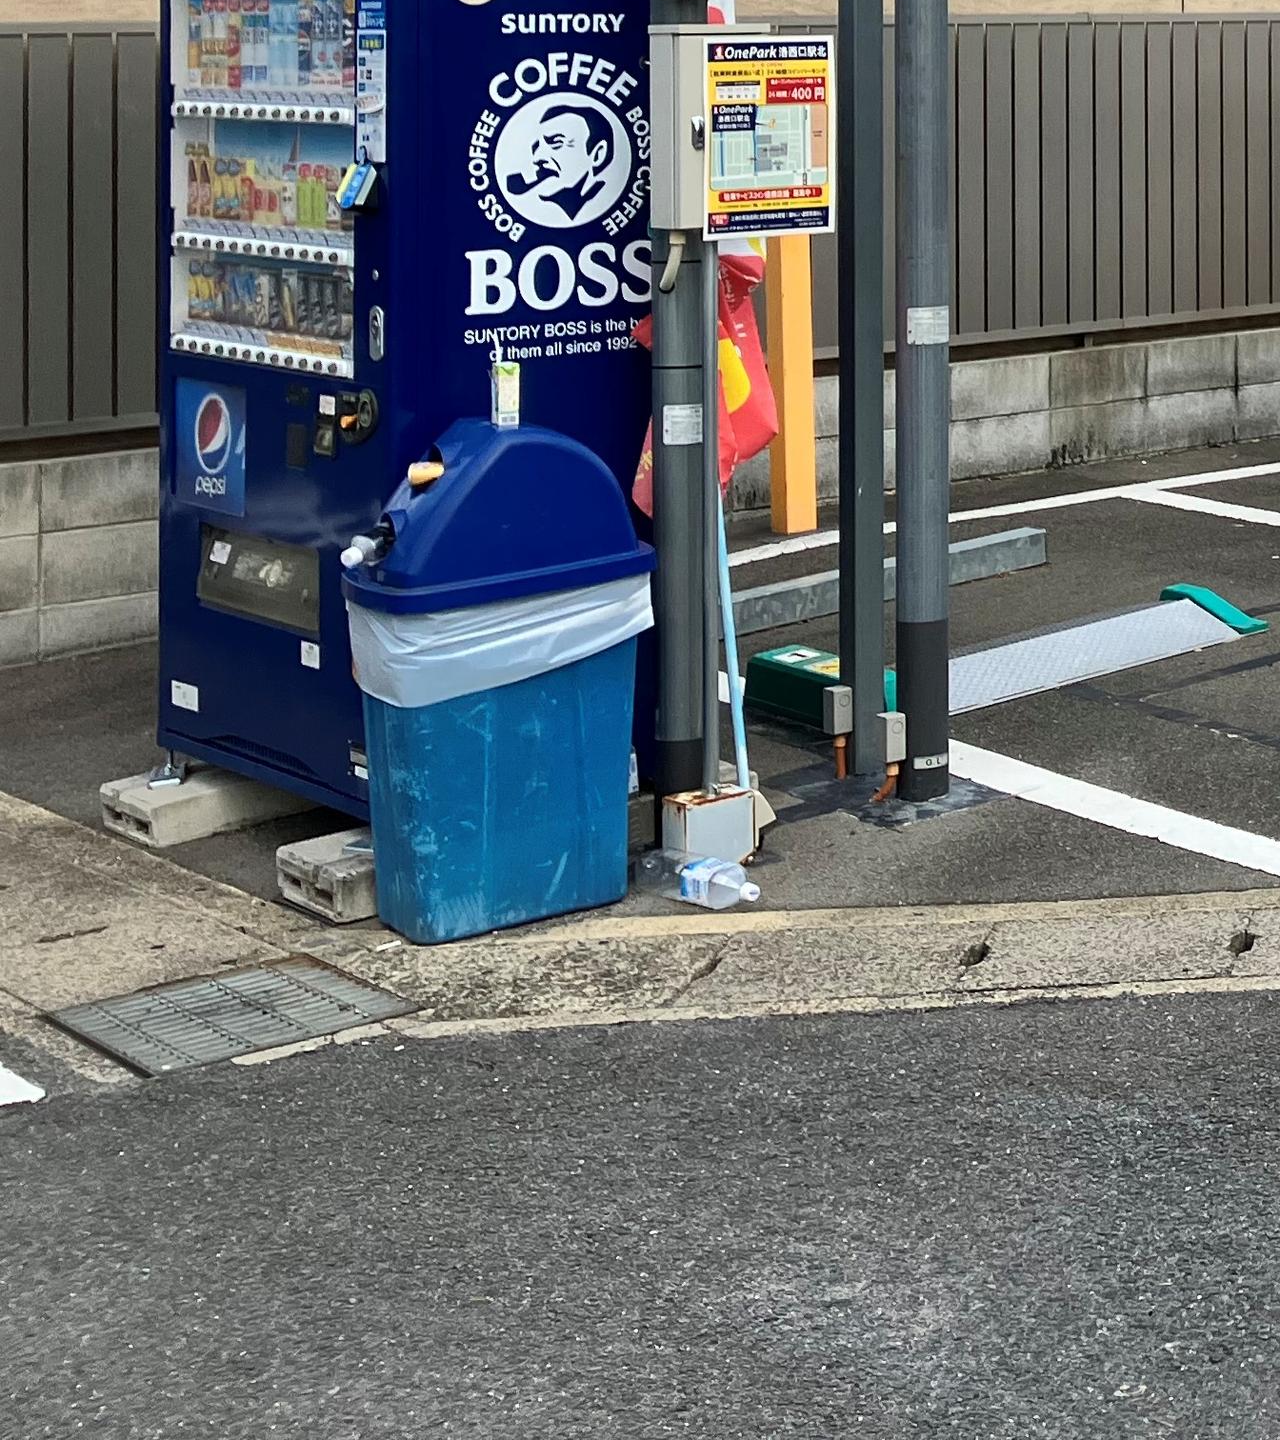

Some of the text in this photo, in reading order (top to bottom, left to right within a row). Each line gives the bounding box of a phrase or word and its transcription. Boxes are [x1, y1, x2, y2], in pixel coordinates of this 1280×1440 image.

[724, 46, 777, 60] OnePark
[488, 52, 638, 108] COFFEE
[467, 109, 525, 243] BOSS COFFEE
[464, 240, 652, 316] BOSS
[464, 324, 541, 345] SUNTORY
[545, 320, 587, 338] BOSS
[590, 320, 602, 334] is
[605, 319, 626, 332] the
[507, 344, 542, 360] them
[546, 342, 563, 356] all
[566, 340, 602, 354] since
[606, 337, 638, 350] 1992
[195, 475, 226, 498] pepsi
